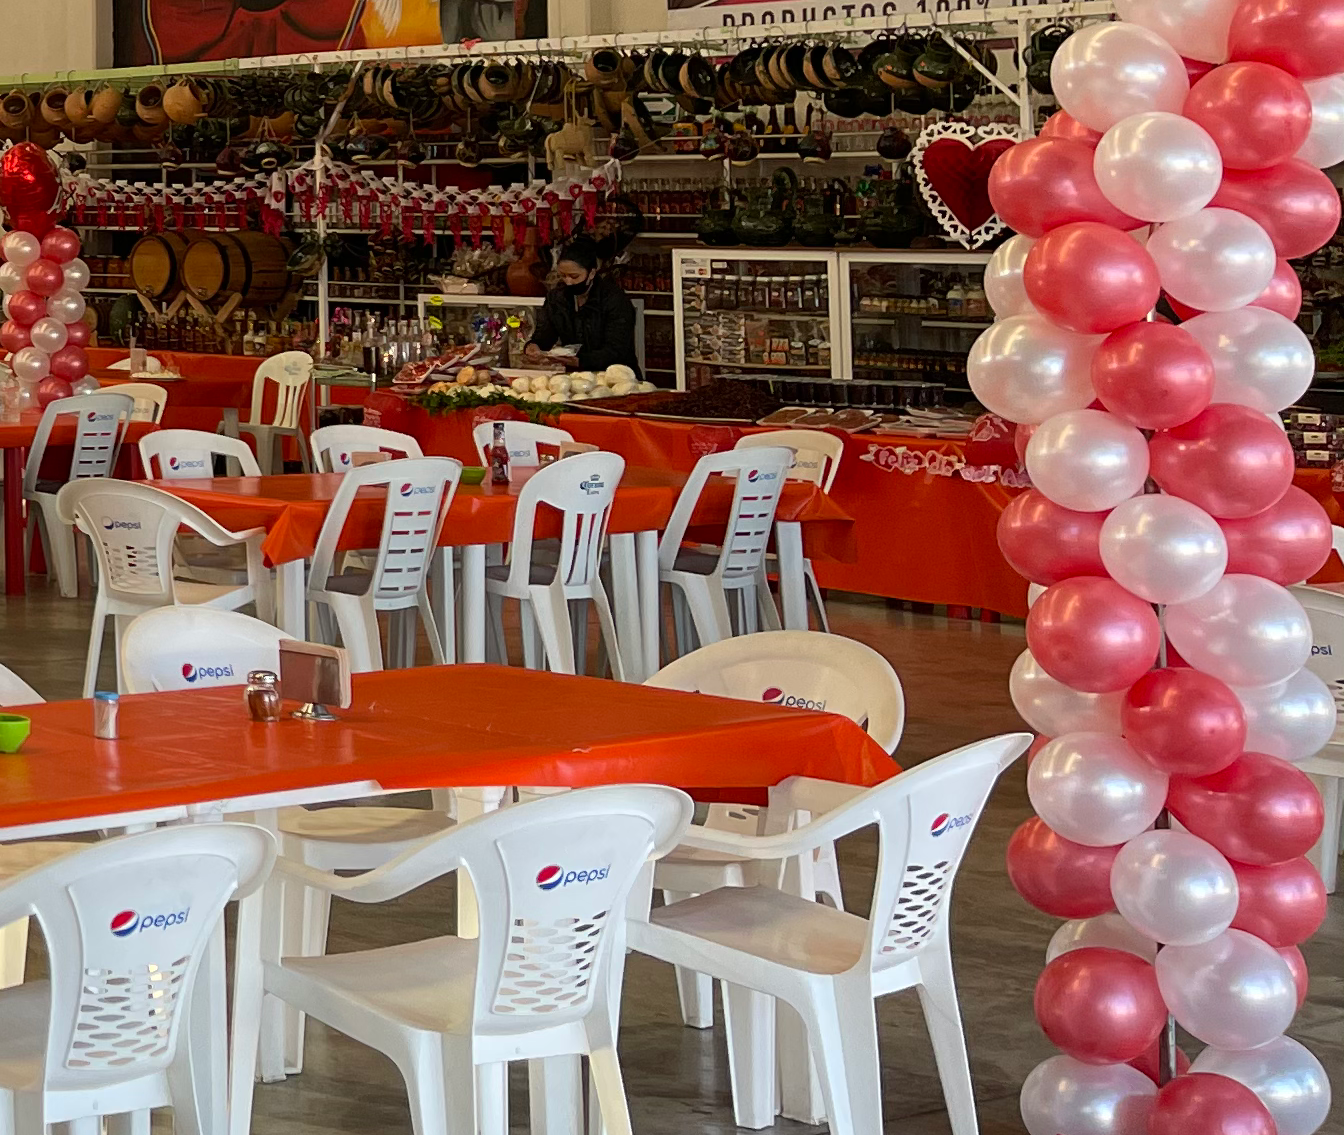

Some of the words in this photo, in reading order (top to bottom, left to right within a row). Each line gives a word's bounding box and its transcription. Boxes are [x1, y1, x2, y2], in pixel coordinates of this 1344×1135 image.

[114, 520, 141, 532] pepsi
[1310, 643, 1332, 658] psi
[197, 664, 234, 681] pepsi
[563, 863, 611, 888] pepsi
[140, 906, 190, 932] pepsi
